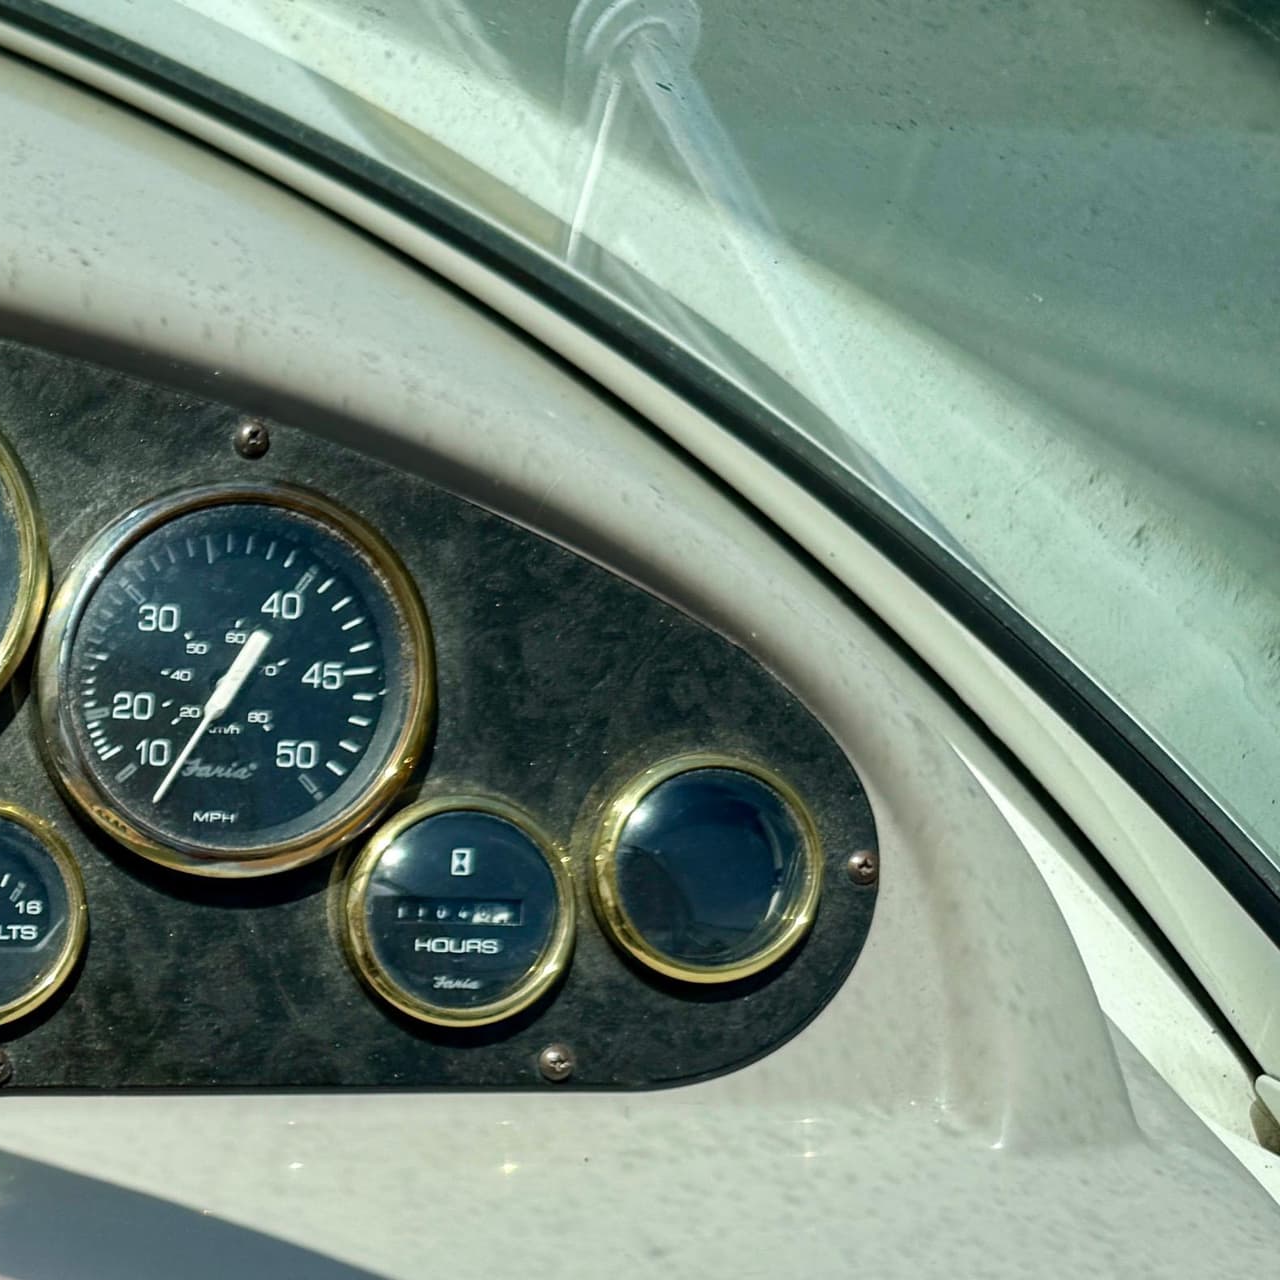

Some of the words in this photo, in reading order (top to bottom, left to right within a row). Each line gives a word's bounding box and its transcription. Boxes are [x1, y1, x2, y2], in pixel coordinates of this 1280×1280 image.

[138, 604, 178, 632] 30
[261, 592, 303, 620] 40
[301, 663, 344, 690] 45
[113, 693, 154, 720] 20
[136, 739, 170, 765] 10
[276, 741, 318, 768] 50
[193, 811, 234, 823] MPH
[415, 938, 498, 953] HOURS
